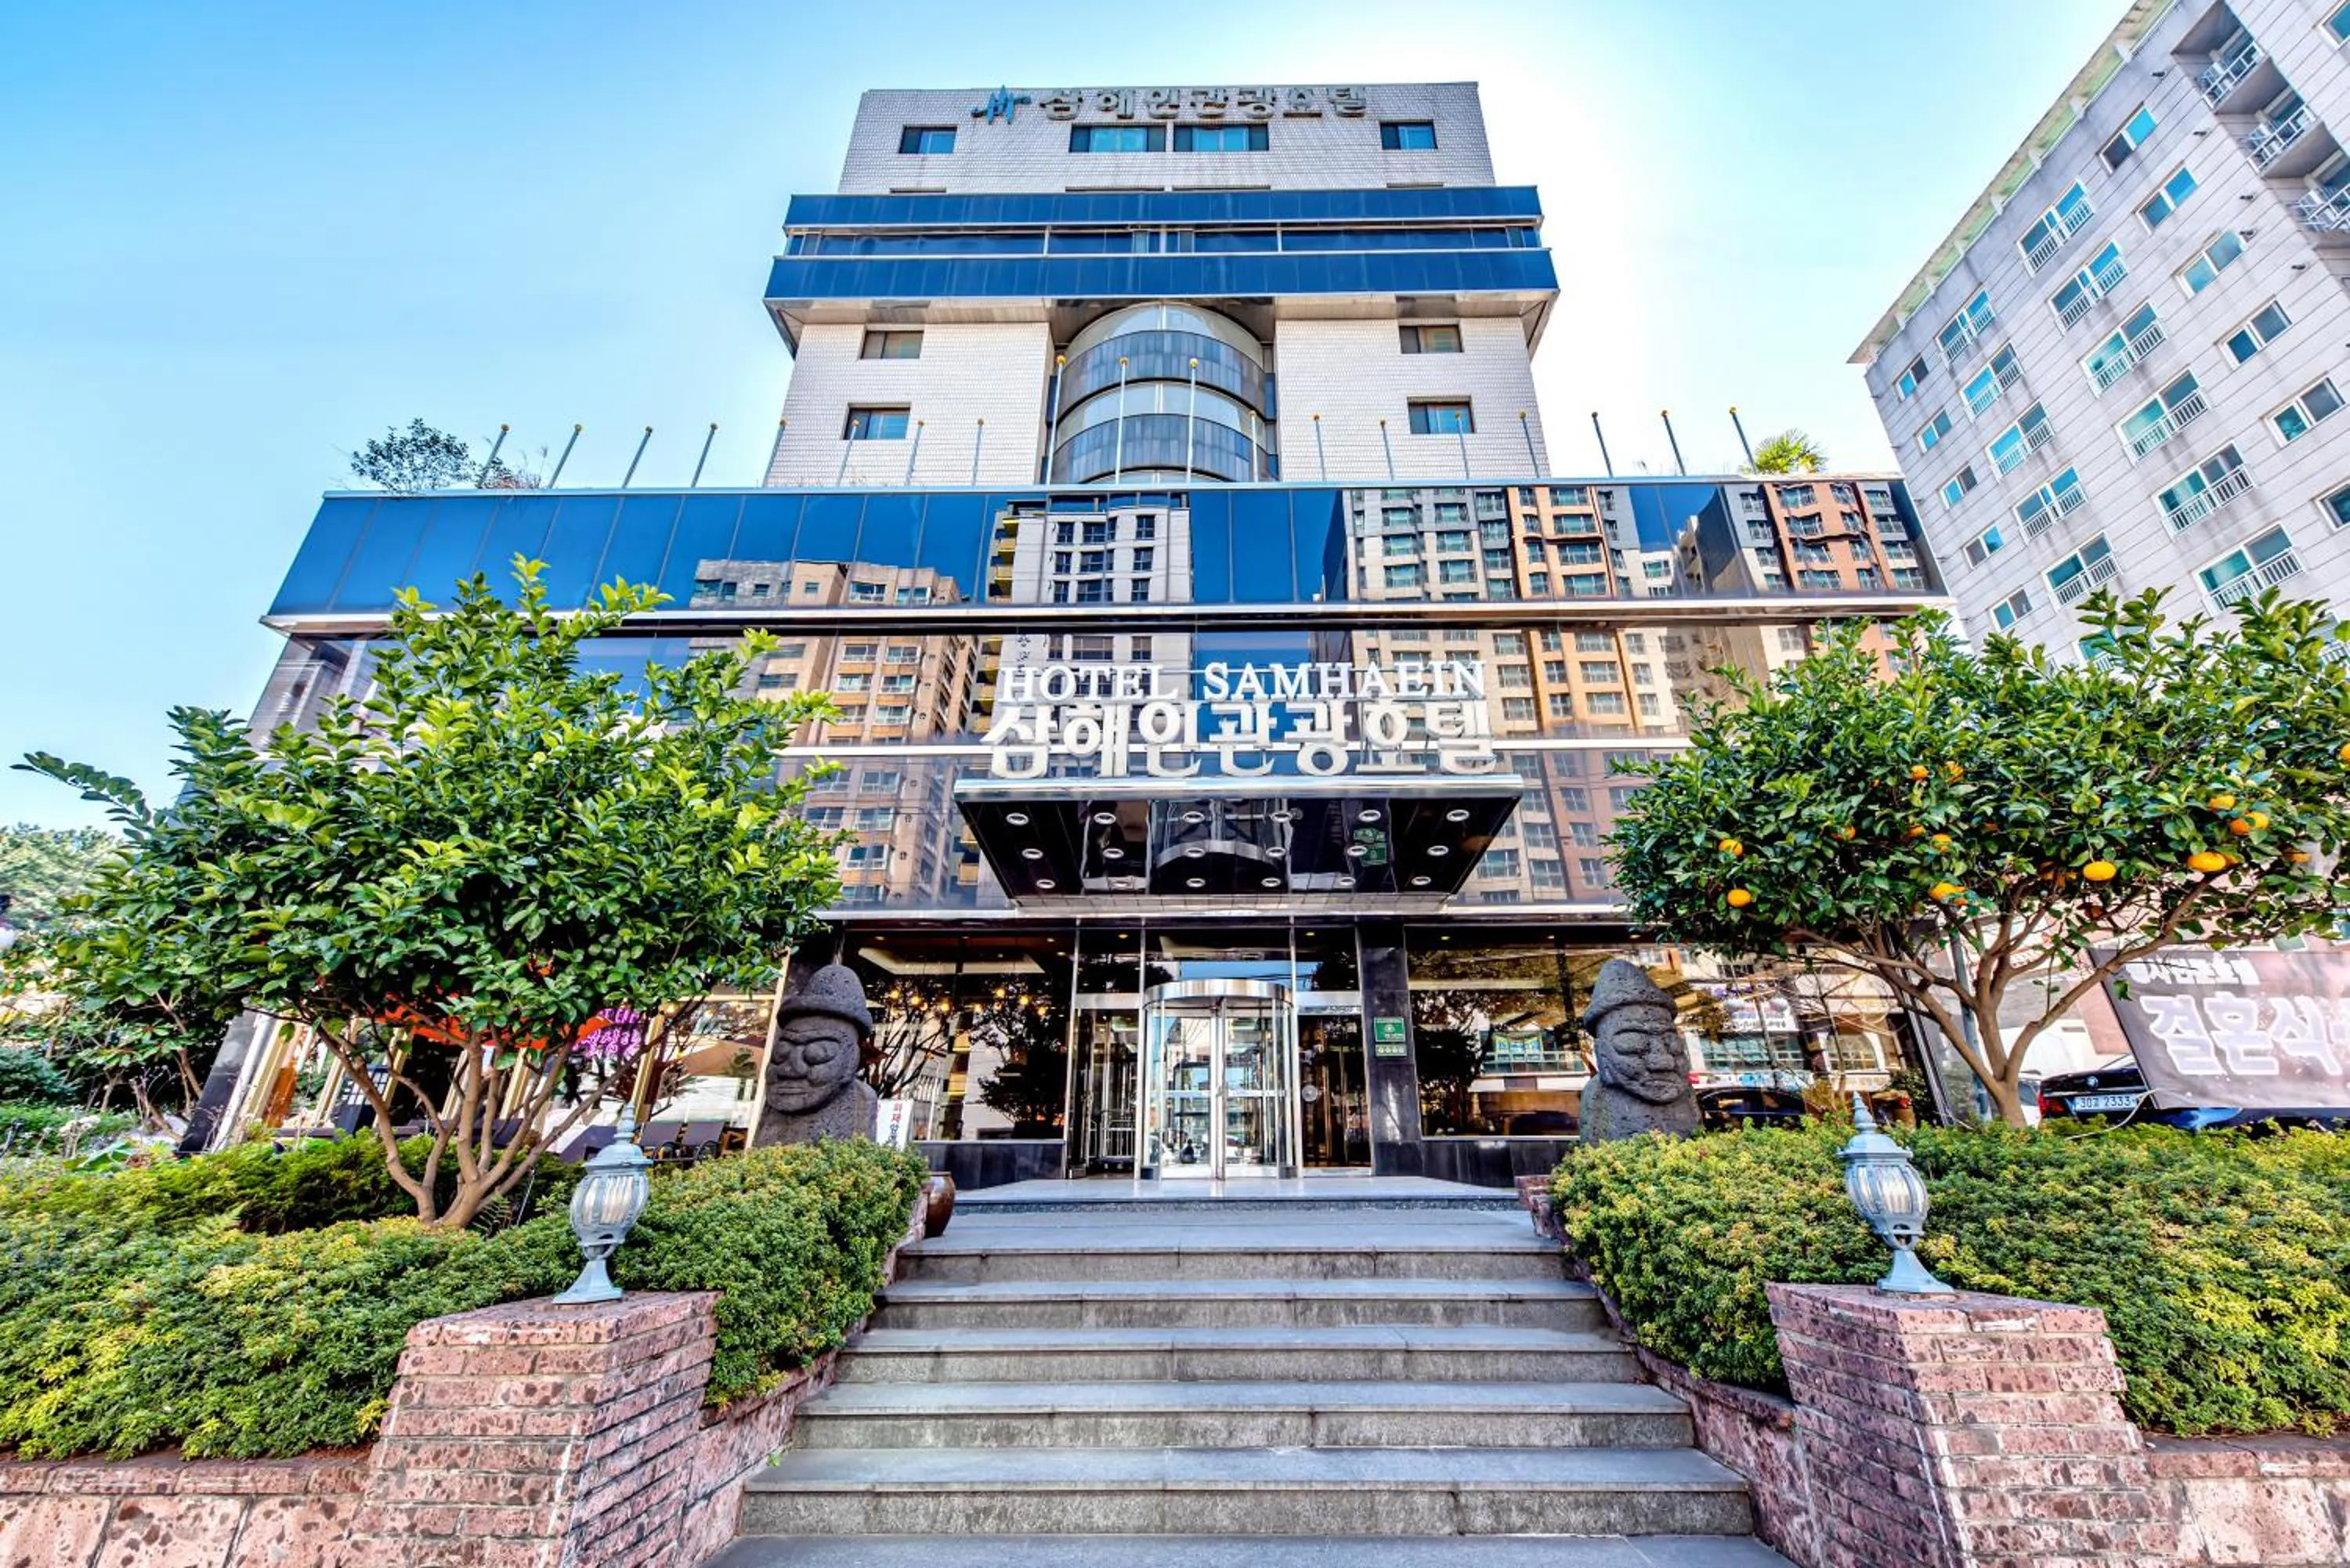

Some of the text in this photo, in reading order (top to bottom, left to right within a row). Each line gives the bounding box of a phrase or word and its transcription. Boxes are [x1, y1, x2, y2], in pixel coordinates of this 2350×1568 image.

[1000, 661, 1484, 702] HOTEL SAMHAEIN
[979, 700, 1497, 779] 삼해인관광호텔
[2103, 1096, 2131, 1107] 2333
